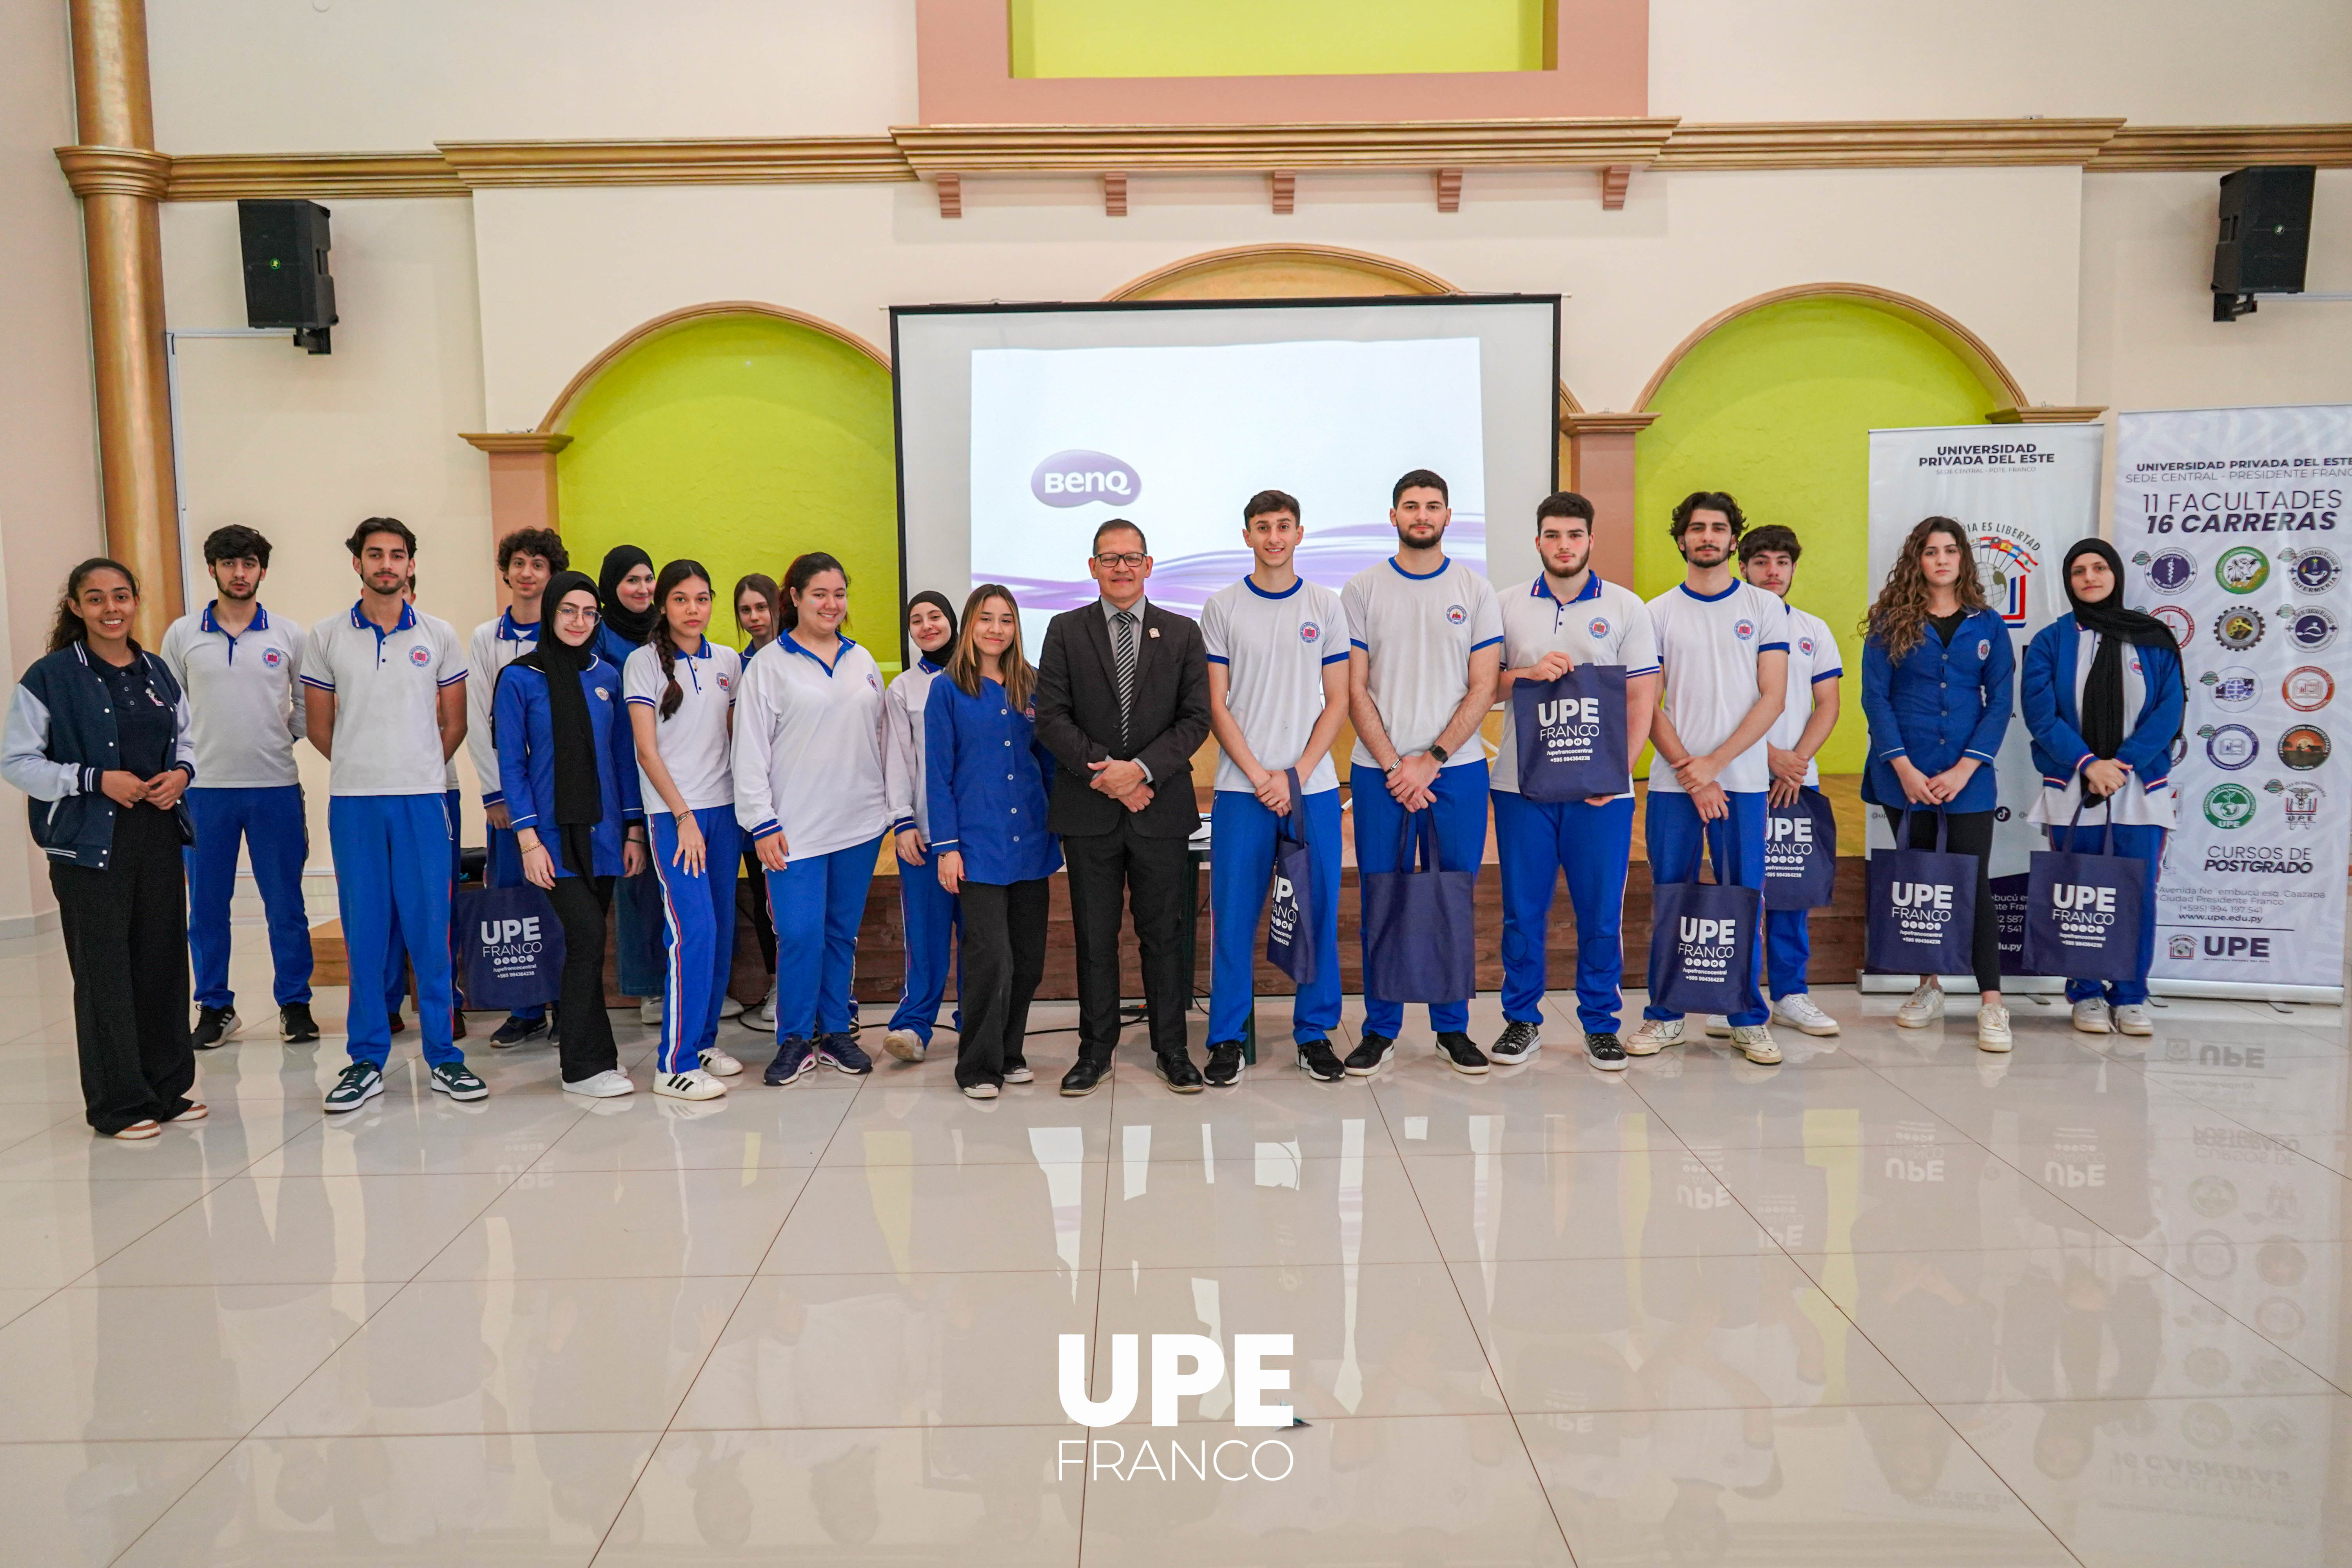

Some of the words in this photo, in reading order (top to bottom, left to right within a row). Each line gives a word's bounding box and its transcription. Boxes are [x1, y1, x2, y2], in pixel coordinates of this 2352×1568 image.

[1938, 444, 2036, 455] UNIVERSIDAD
[1919, 456, 1984, 466] PRIVADA
[1989, 455, 2015, 464] DEL
[2020, 454, 2054, 463] ESTE
[2137, 461, 2225, 471] UNIVERSIDAD
[2230, 459, 2289, 468] PRIVADA
[2294, 459, 2320, 467] DEL
[1044, 470, 1132, 495] BenQ
[2126, 474, 2158, 483] SEDE
[2162, 472, 2218, 482] CENTRAL
[2230, 469, 2308, 479] PRESIDENTE
[2313, 469, 2352, 477] FRANC
[2143, 494, 2158, 513] 11
[2169, 490, 2342, 512] FACULTADES
[2147, 515, 2174, 534] 16
[2181, 512, 2337, 533] CARRERAS
[1982, 522, 1992, 531] ES
[1996, 523, 2040, 551] LIBERTAD
[1538, 697, 1599, 727] UPE
[1540, 724, 1599, 741] FRANCO
[2208, 846, 2283, 860] CURSOS
[2290, 848, 2312, 860] DE
[2204, 859, 2314, 874] POSTGRADO
[1892, 882, 1953, 909] UPE
[2054, 883, 2116, 912] UPE
[1892, 907, 1951, 922] FRANCO
[2052, 909, 2114, 925] FRANCO
[2179, 914, 2263, 923] www.upe.edu.py
[481, 916, 541, 945] UPE
[1680, 916, 1735, 945] UPE
[483, 942, 542, 957] FRANCO
[1678, 943, 1734, 958] FRANCO
[2205, 936, 2270, 957] UPE
